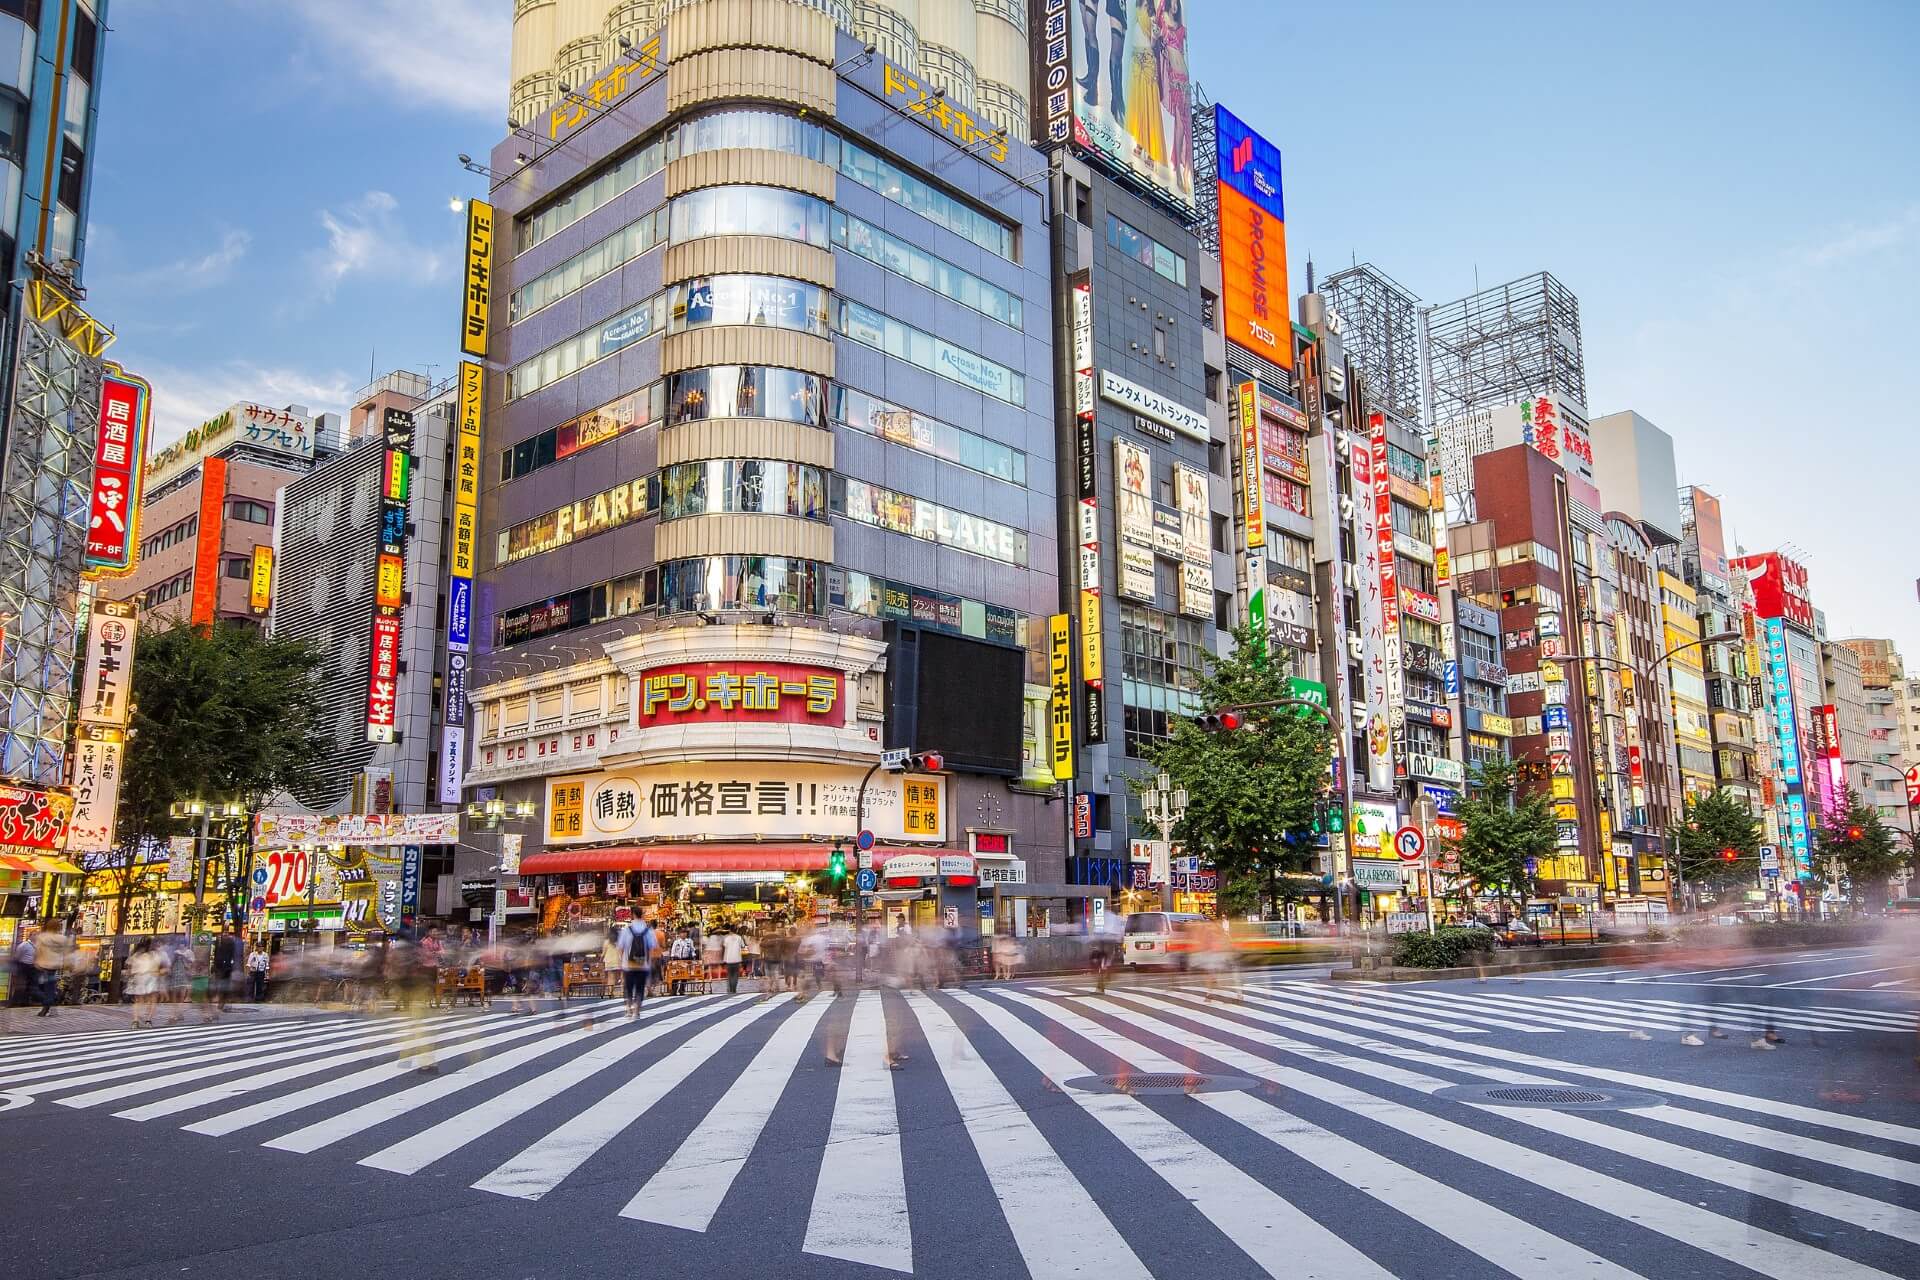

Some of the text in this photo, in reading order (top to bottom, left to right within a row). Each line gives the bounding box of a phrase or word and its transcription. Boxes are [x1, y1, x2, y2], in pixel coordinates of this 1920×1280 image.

[1249, 207, 1268, 321] PROMISE
[1248, 320, 1276, 348] プロミス
[464, 370, 483, 432] ブランド品
[1106, 378, 1207, 430] エンタメレストランタワー
[1307, 384, 1318, 423] 水上ビル
[102, 399, 130, 465] 居酒屋
[245, 423, 313, 451] カプセル
[1140, 419, 1175, 440] SQUARE
[461, 445, 475, 494] 貴金属
[556, 477, 647, 537] FLARE
[915, 499, 1013, 553] FLARE
[457, 512, 471, 570] 高額買取
[104, 602, 129, 616] 6F
[381, 606, 395, 615] 6F
[886, 589, 909, 609] 販売
[913, 599, 936, 611] ブランド
[377, 634, 393, 678] 居楽屋
[1445, 661, 1455, 695] 747
[1089, 693, 1098, 737] ミステリアス
[90, 729, 114, 740] 5F
[1826, 713, 1838, 748] SHIDAX
[449, 741, 457, 784] 写真スタジオ
[446, 786, 456, 797] 5F
[554, 787, 581, 807] 情熱
[596, 788, 636, 820] 情熱
[907, 785, 936, 805] 情熱
[553, 811, 580, 832] 価格
[907, 808, 936, 831] 価格
[1761, 847, 1771, 859] P
[265, 850, 308, 904] 270
[338, 868, 365, 881] カラオケ
[403, 849, 417, 902] カラオケ
[862, 874, 869, 887] P
[341, 899, 370, 922] 747
[384, 881, 397, 925] カラオケ
[402, 905, 414, 914] B1
[1095, 900, 1103, 914] P
